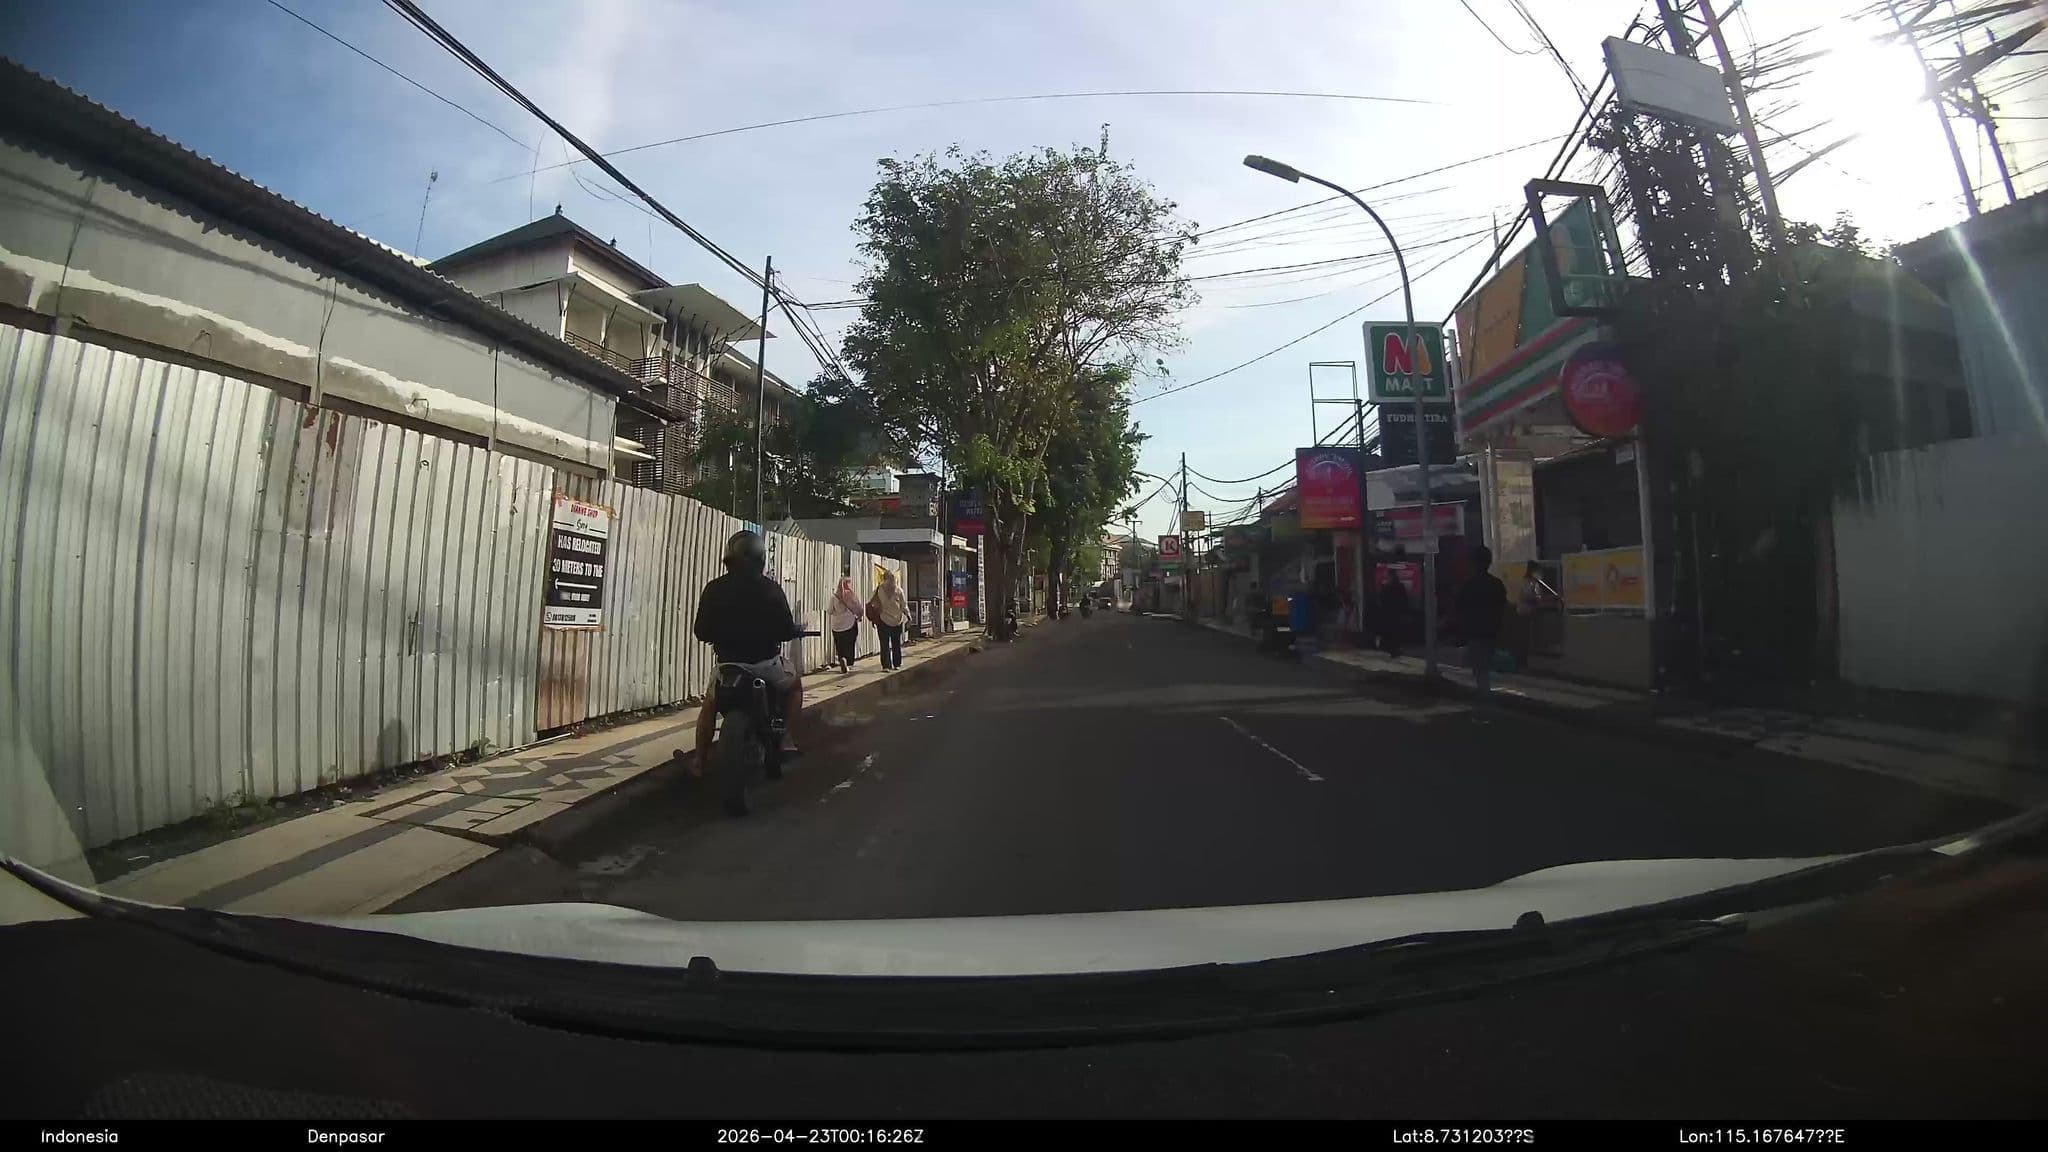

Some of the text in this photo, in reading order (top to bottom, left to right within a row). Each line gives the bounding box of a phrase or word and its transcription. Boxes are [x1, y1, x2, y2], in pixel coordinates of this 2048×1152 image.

[1385, 377, 1433, 391] MAT
[558, 535, 601, 555] HAS RELOCATED
[561, 559, 584, 575] METERS
[585, 562, 593, 576] TO
[593, 564, 603, 578] THE
